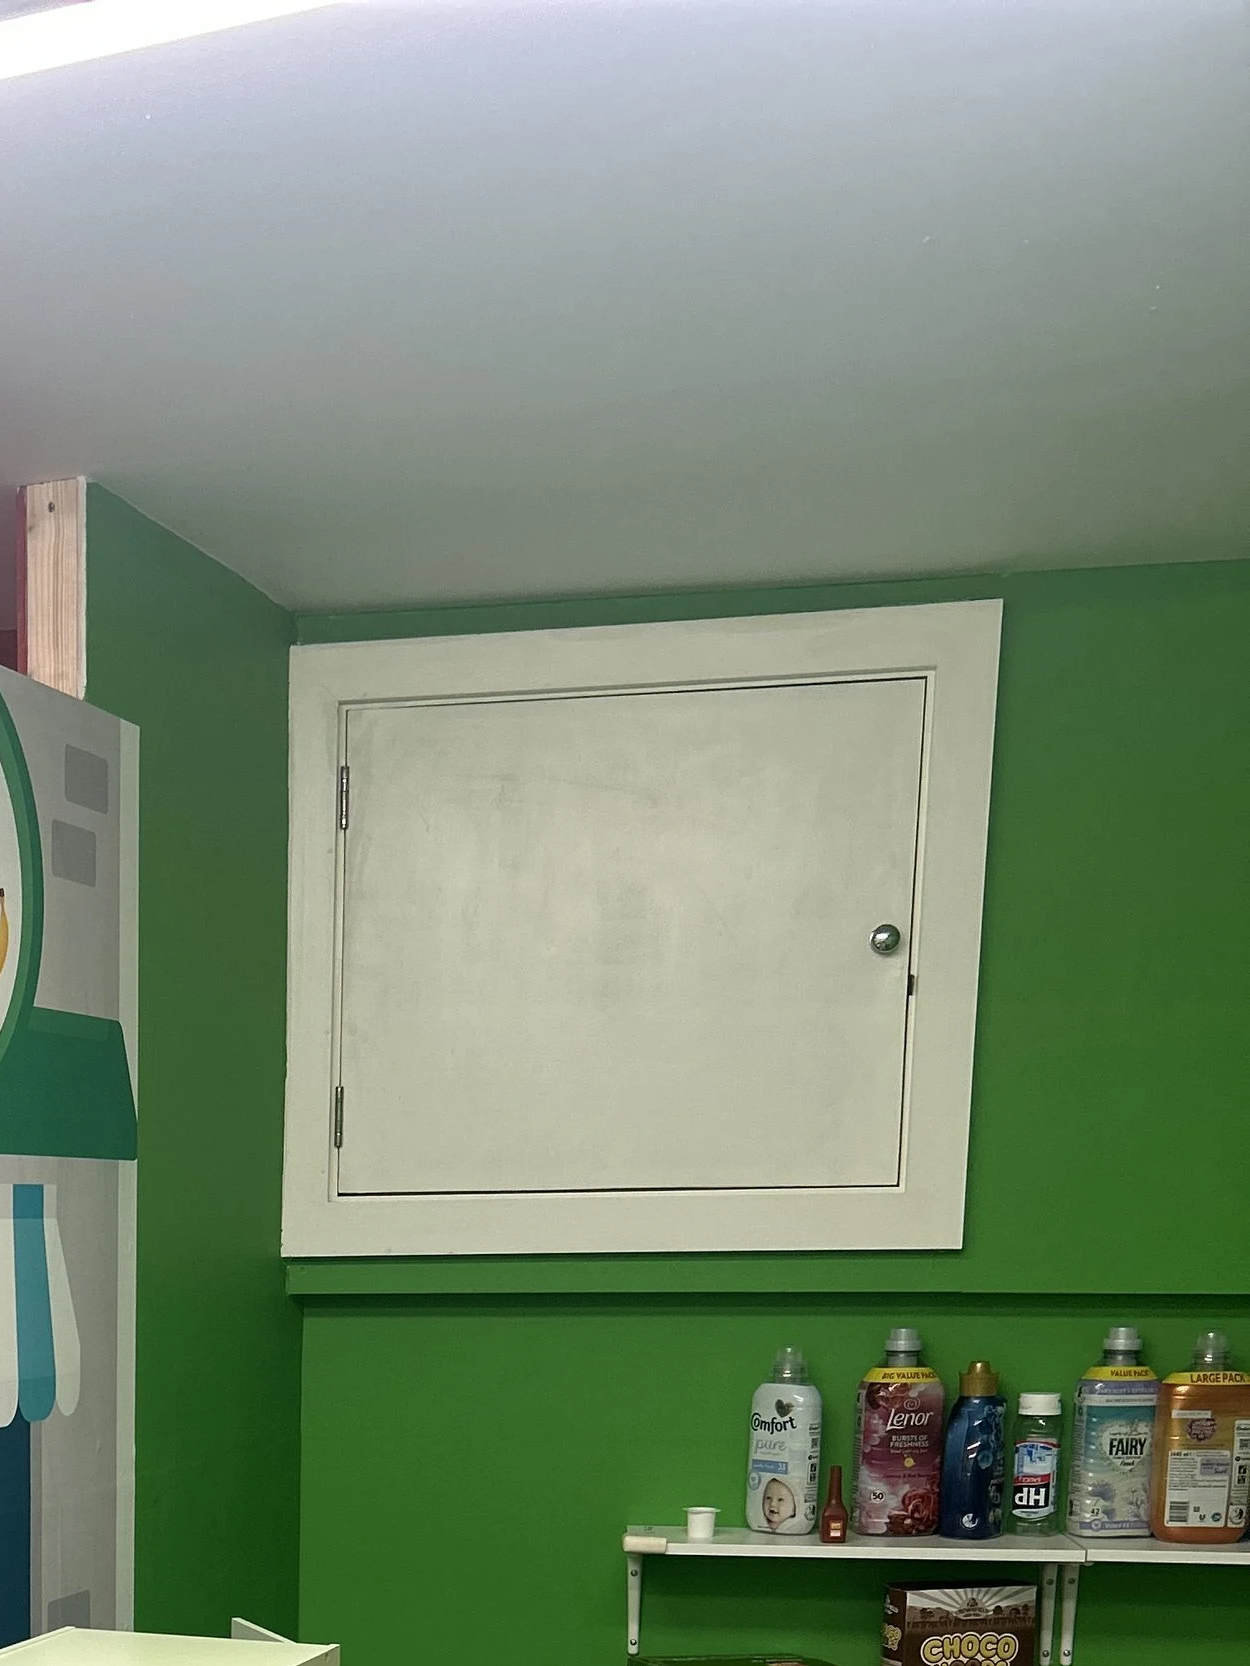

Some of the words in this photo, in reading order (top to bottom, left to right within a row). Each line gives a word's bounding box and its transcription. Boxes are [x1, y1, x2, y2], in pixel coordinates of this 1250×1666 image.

[1110, 1369, 1132, 1377] VALUE
[1190, 1373, 1221, 1383] LARGE
[1222, 1373, 1245, 1383] PACK
[751, 1412, 797, 1435] Comfort
[886, 1408, 934, 1431] Lenor
[754, 1439, 787, 1455] pure
[1109, 1437, 1147, 1456] FAIRY
[872, 1492, 884, 1500] 50
[1014, 1487, 1046, 1506] HP
[922, 1633, 1017, 1664] CHOCO
